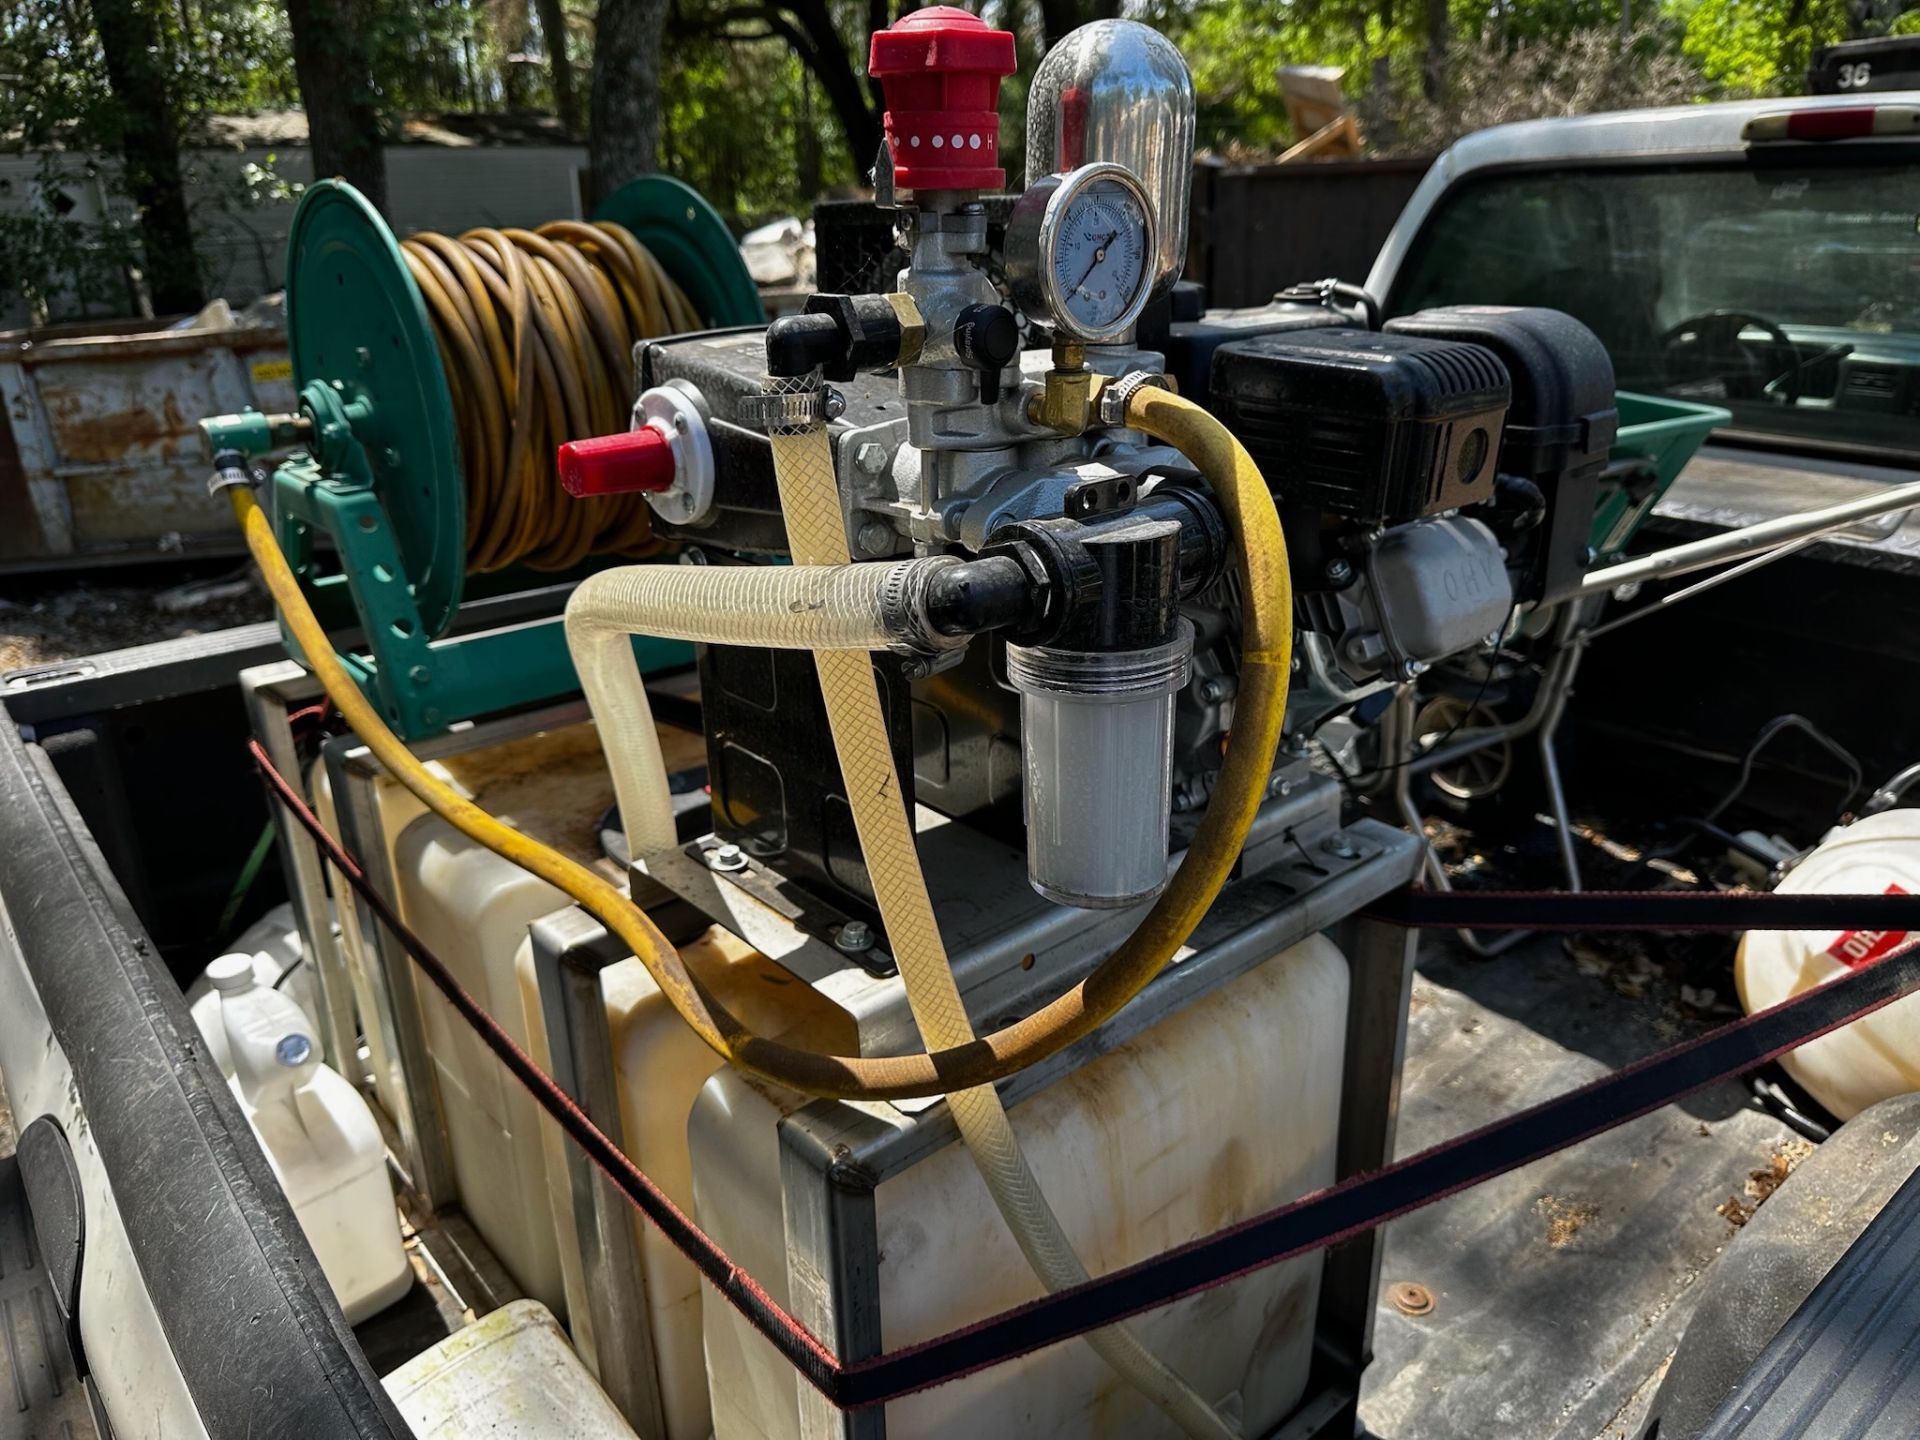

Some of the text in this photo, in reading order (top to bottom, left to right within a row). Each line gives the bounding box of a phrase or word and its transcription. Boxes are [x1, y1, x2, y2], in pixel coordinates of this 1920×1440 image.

[1837, 62, 1871, 89] 36
[987, 133, 993, 150] H
[1443, 555, 1494, 602] OHV
